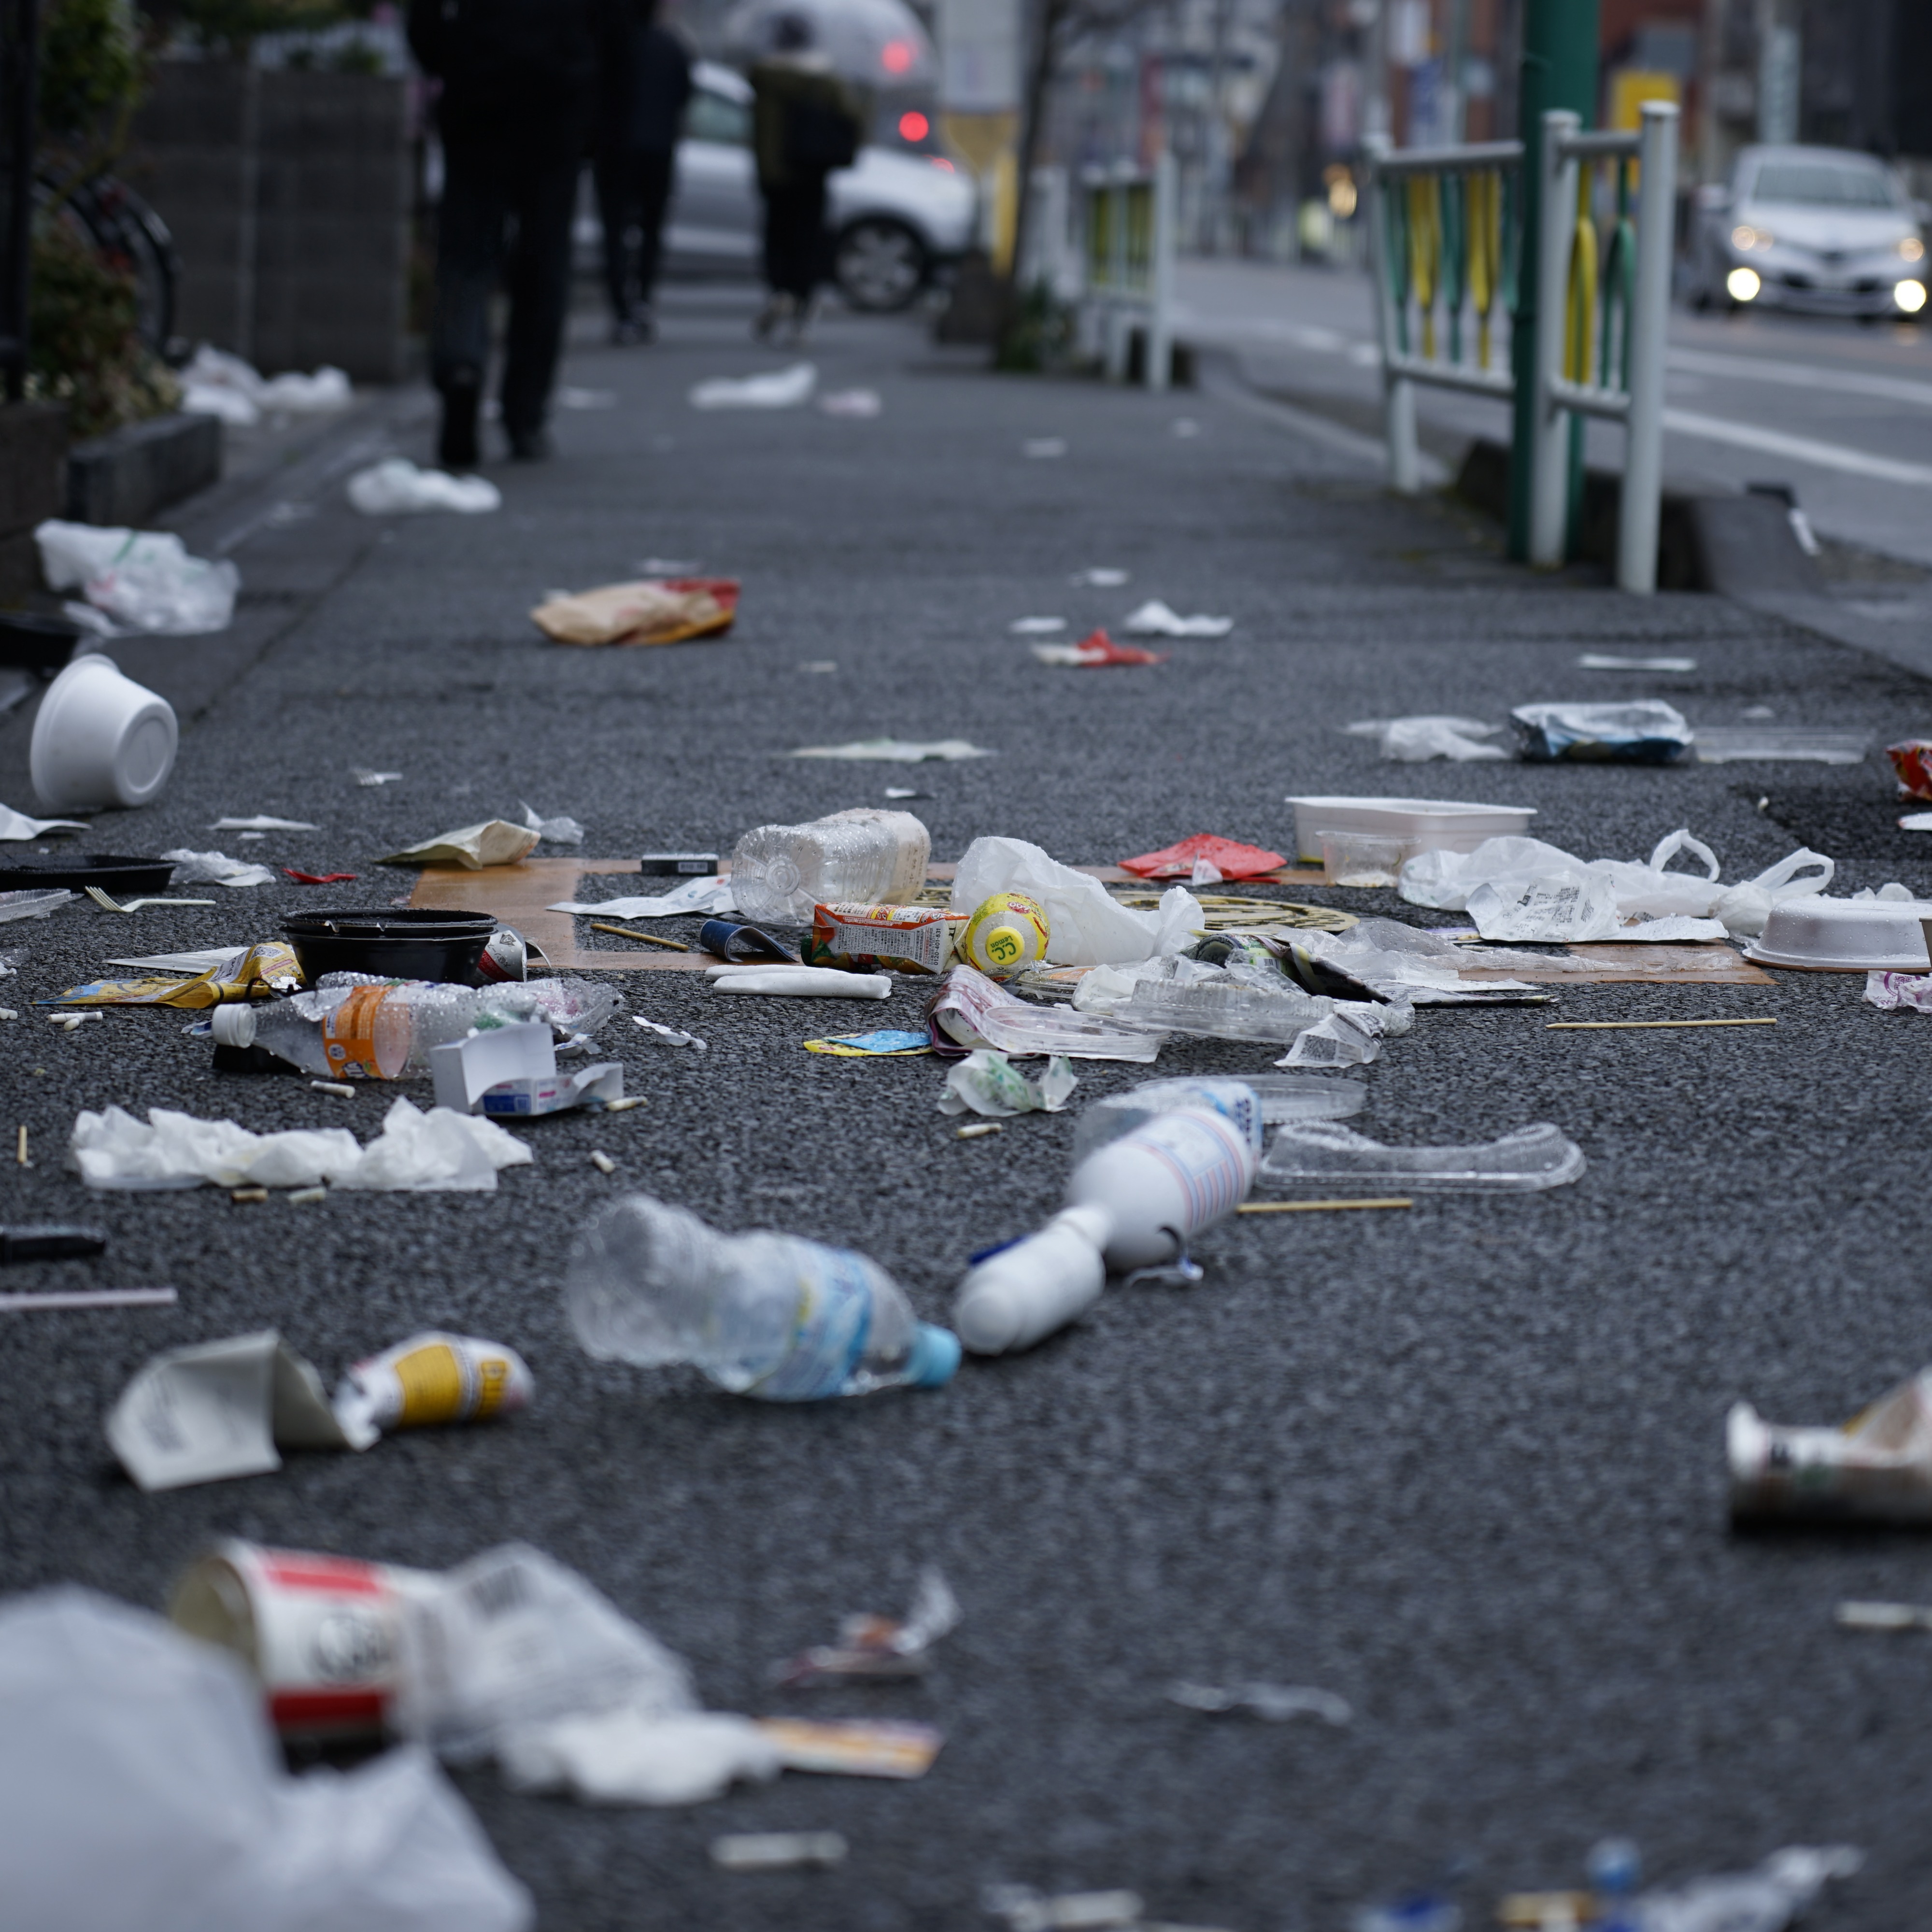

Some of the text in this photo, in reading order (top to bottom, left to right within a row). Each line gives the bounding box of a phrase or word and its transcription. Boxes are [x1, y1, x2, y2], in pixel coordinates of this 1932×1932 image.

[909, 847, 918, 884] 天然水
[990, 935, 1014, 948] Lemon
[991, 942, 1016, 961] C.C.
